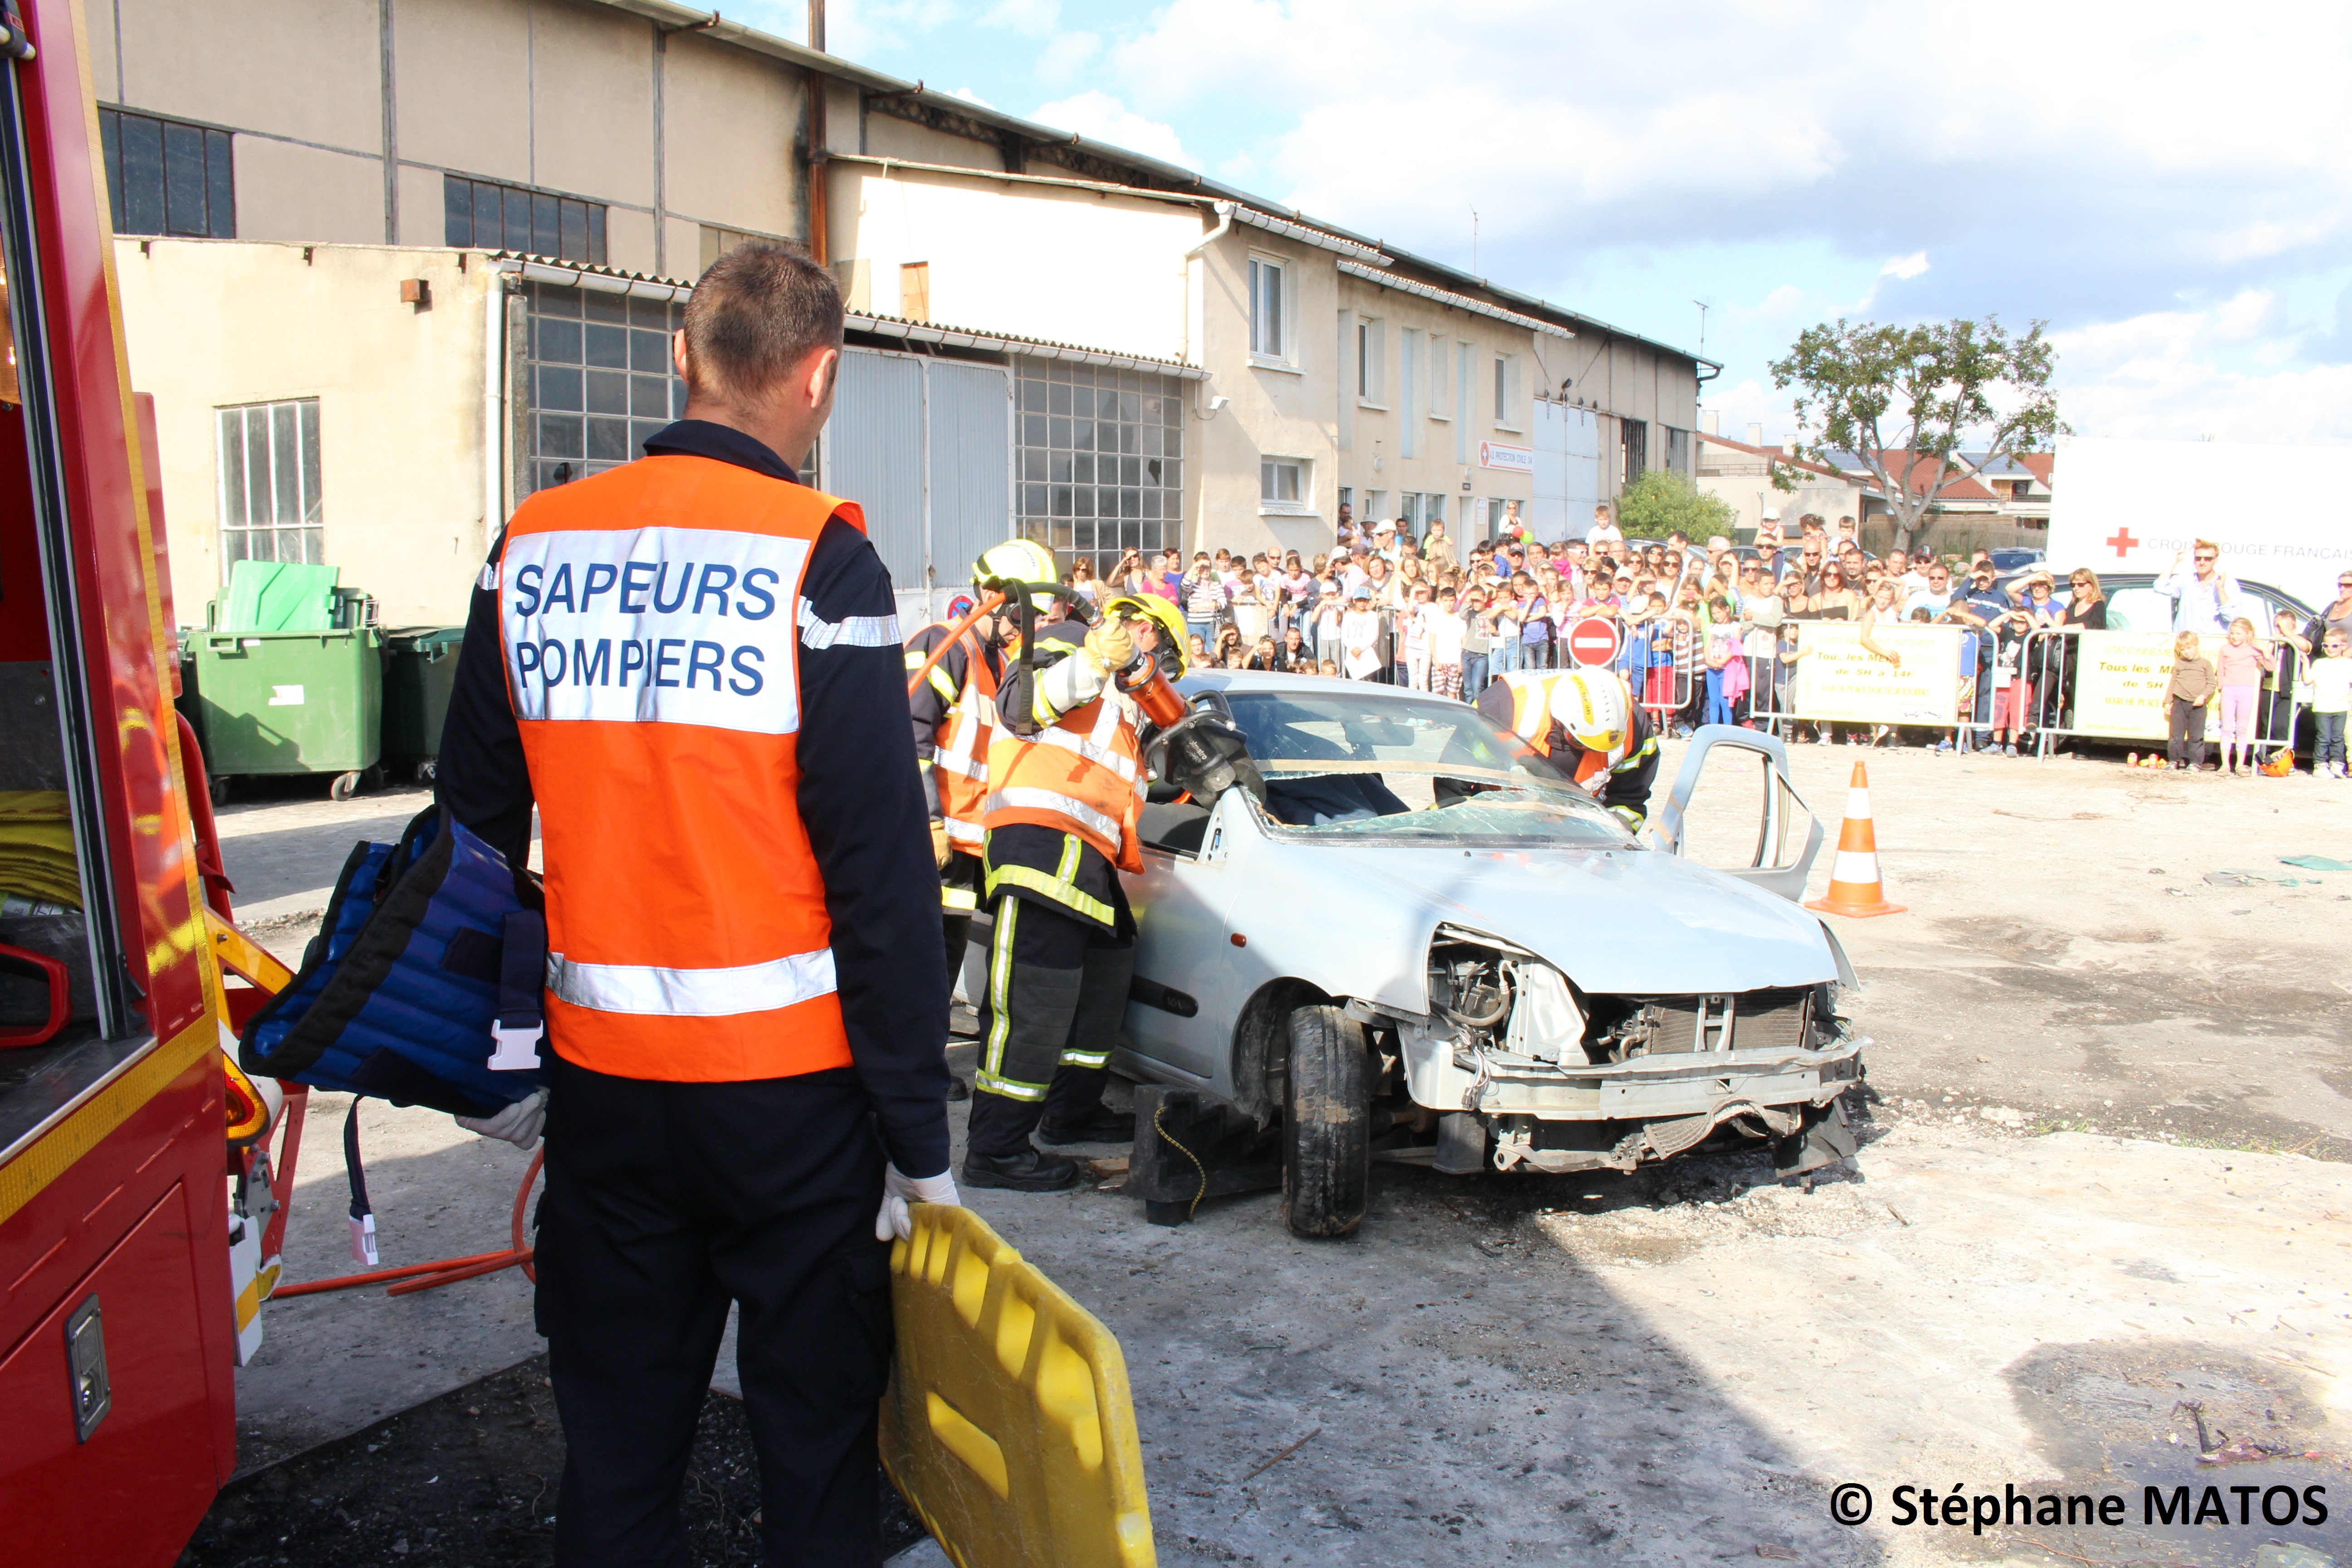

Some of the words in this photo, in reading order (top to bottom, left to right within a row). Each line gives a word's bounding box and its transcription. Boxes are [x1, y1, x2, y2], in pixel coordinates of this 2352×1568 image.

[1495, 451, 1515, 462] PROTECTION
[1516, 454, 1526, 464] CIVILE
[2216, 542, 2268, 555] OUGE
[515, 560, 779, 620] SAPEURS
[1847, 653, 1863, 662] les
[516, 638, 765, 696] POMPIERS
[2099, 662, 2127, 672] Tous
[2132, 664, 2150, 673] les
[1868, 686, 1900, 695] DOCTEUR
[2104, 697, 2134, 706] MARCHE
